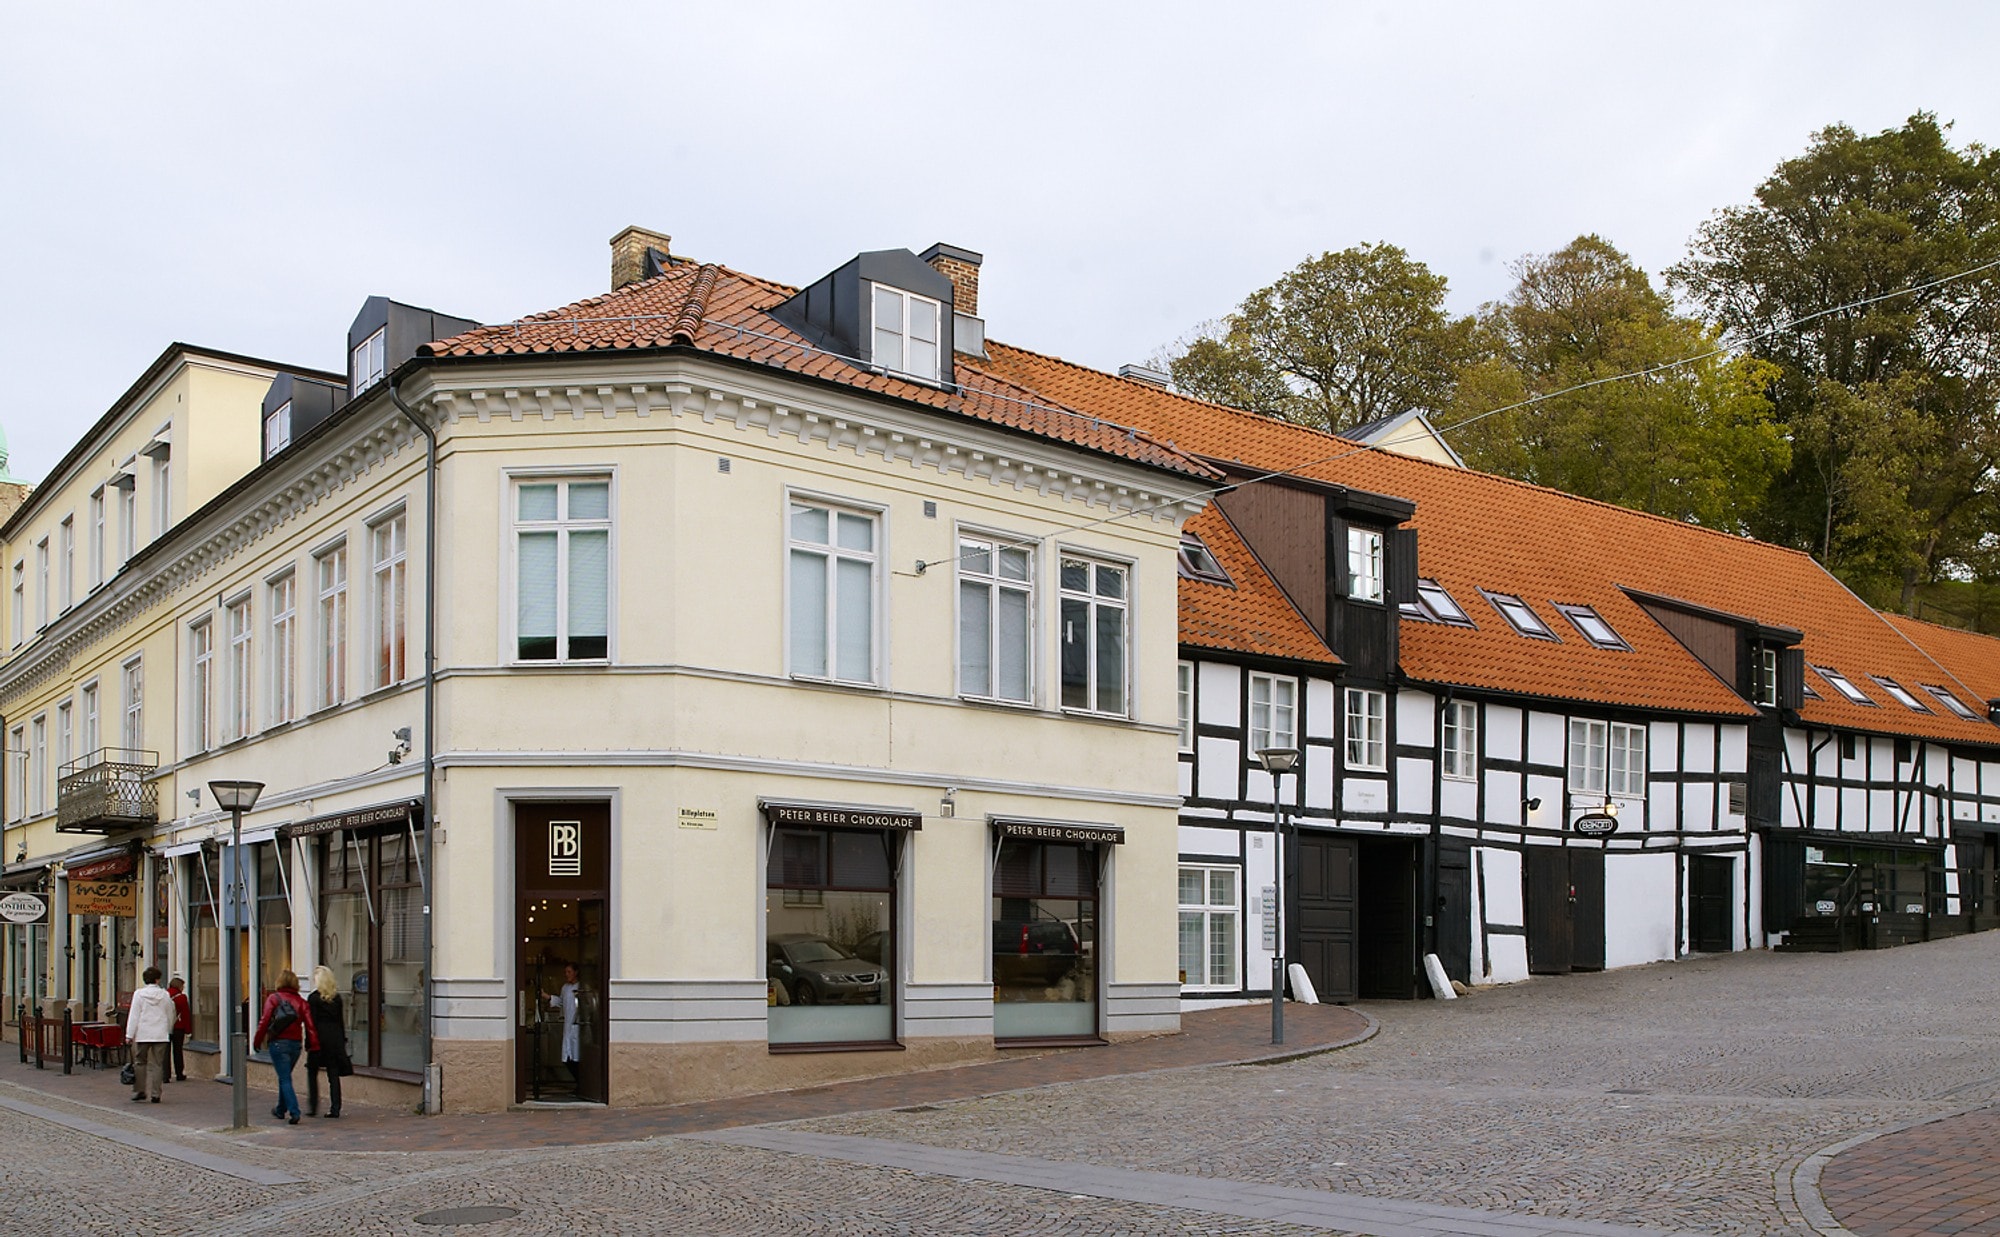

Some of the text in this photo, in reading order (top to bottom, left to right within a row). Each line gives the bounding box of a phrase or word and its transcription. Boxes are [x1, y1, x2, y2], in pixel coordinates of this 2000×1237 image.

[316, 818, 342, 831] CHOKOLADE
[346, 806, 406, 826] PETER BEIER CHOKOLADE
[780, 809, 914, 828] PETER BEIER CHOKOLADE
[553, 825, 577, 856] PB
[1006, 825, 1118, 842] PETER BEIER CHOKOLADE
